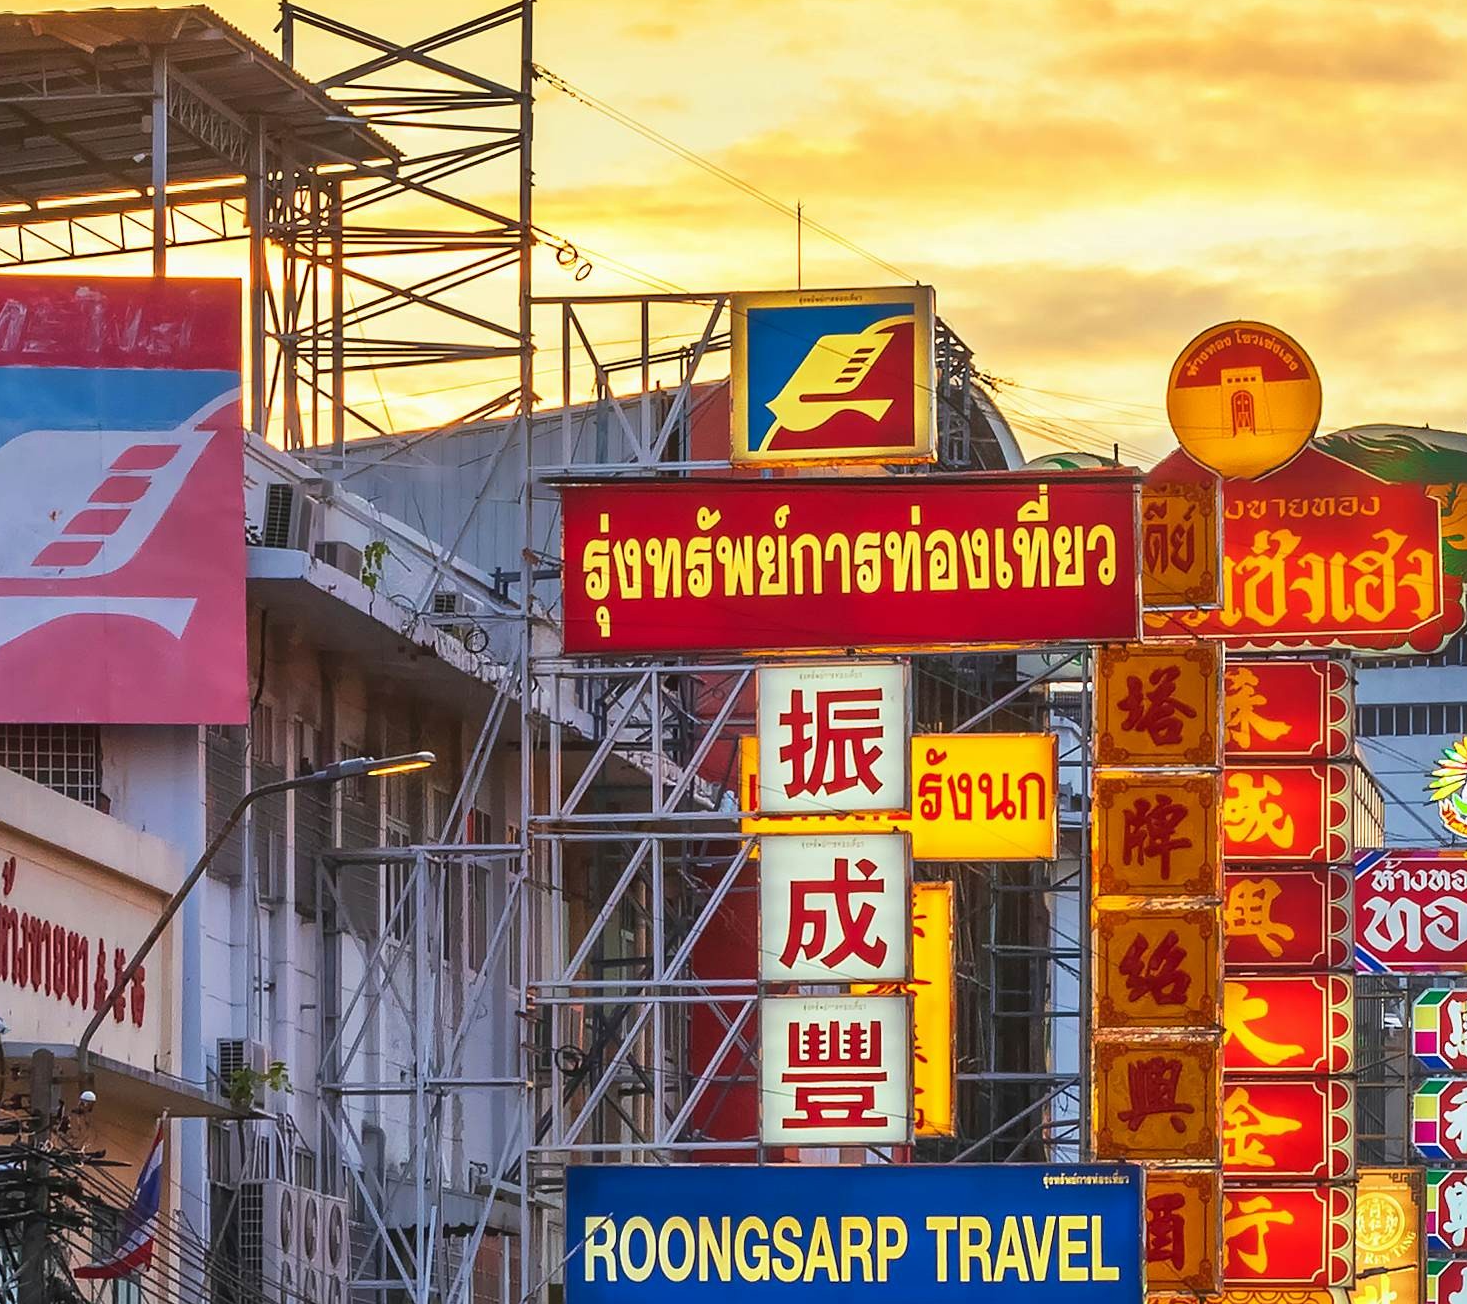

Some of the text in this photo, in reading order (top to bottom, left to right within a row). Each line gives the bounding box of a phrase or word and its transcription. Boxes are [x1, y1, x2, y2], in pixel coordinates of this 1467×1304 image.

[1224, 497, 1380, 522] งขายทอง
[583, 486, 1119, 638] รุ่งทรัพย์การท่องเที่ยว
[1224, 527, 1444, 629] เซ่งเฮง
[779, 687, 890, 1130] 振成豐
[584, 1216, 1120, 1282] ROONGSARP TRAVEL
